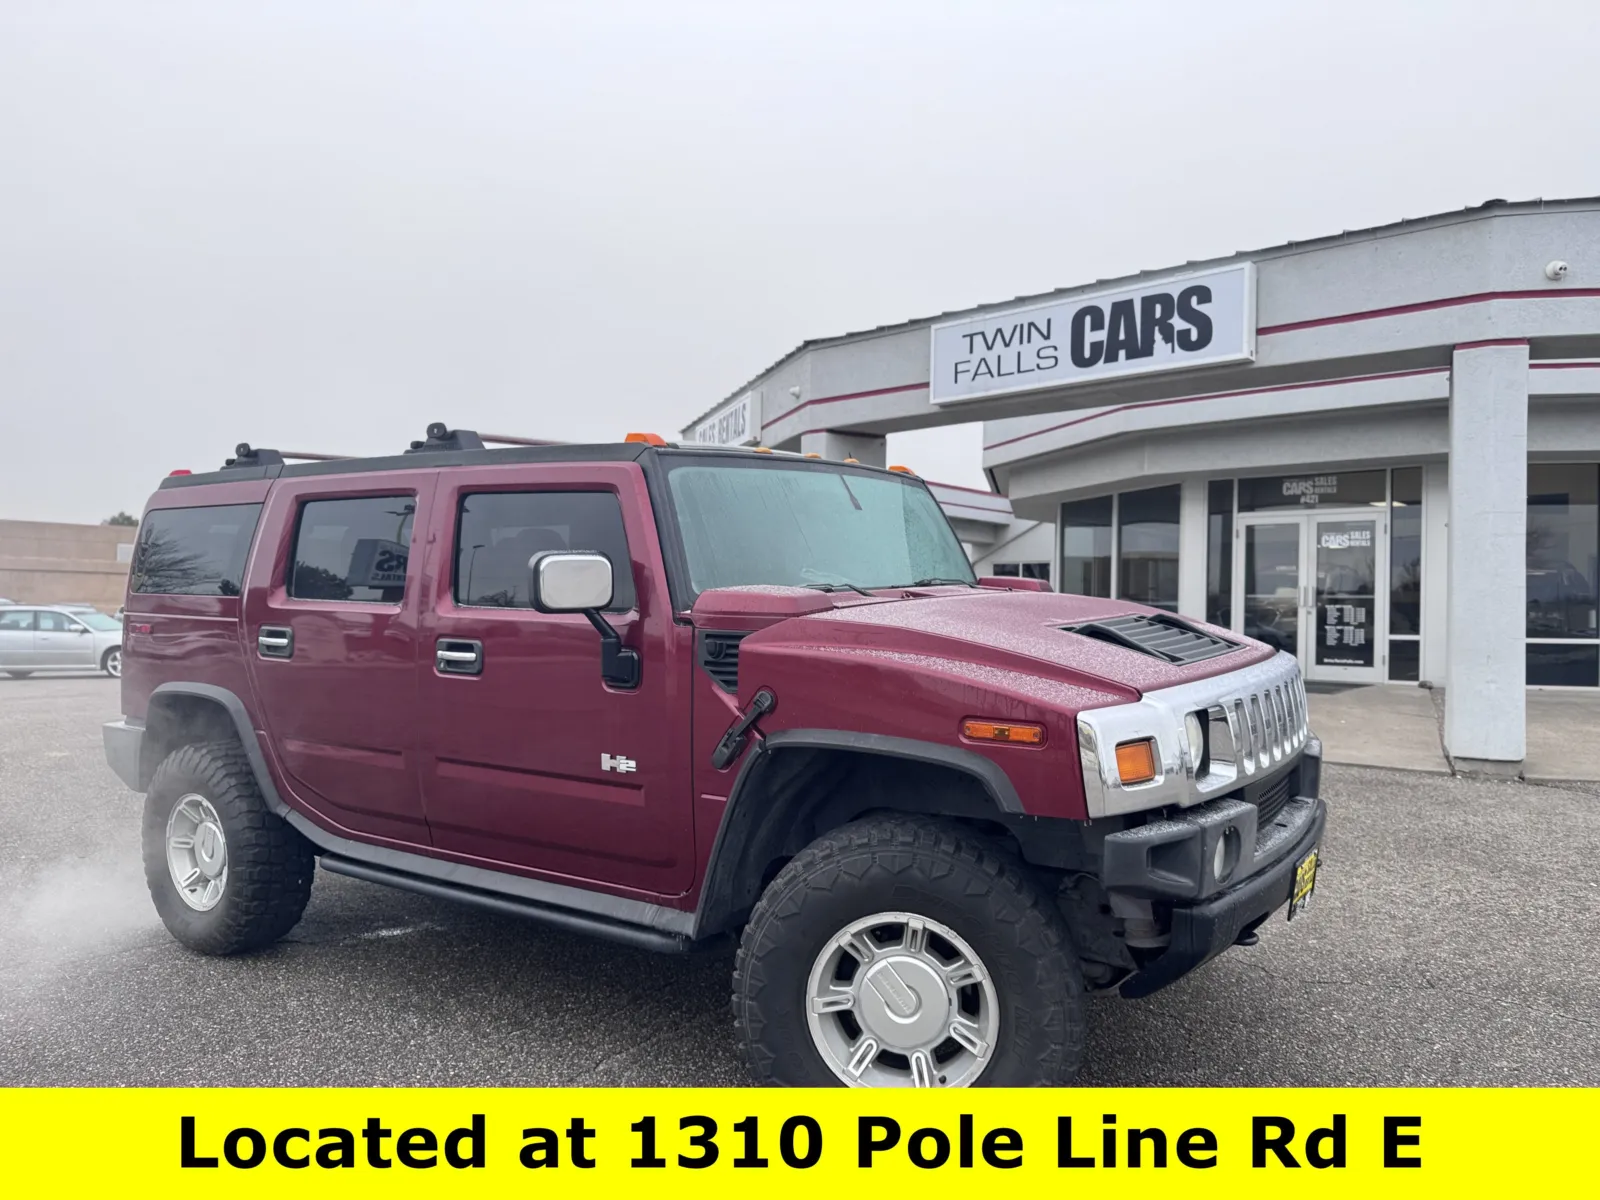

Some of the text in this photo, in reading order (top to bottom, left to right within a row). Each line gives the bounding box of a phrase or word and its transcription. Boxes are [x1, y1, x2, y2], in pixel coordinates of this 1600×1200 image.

[962, 317, 1051, 354] TWIN
[1070, 284, 1213, 369] CARS
[954, 345, 1059, 384] FALLS
[718, 402, 747, 444] RENTALS
[1282, 476, 1337, 496] CARS SALES
[1321, 534, 1350, 548] CARS
[601, 752, 636, 773] H2
